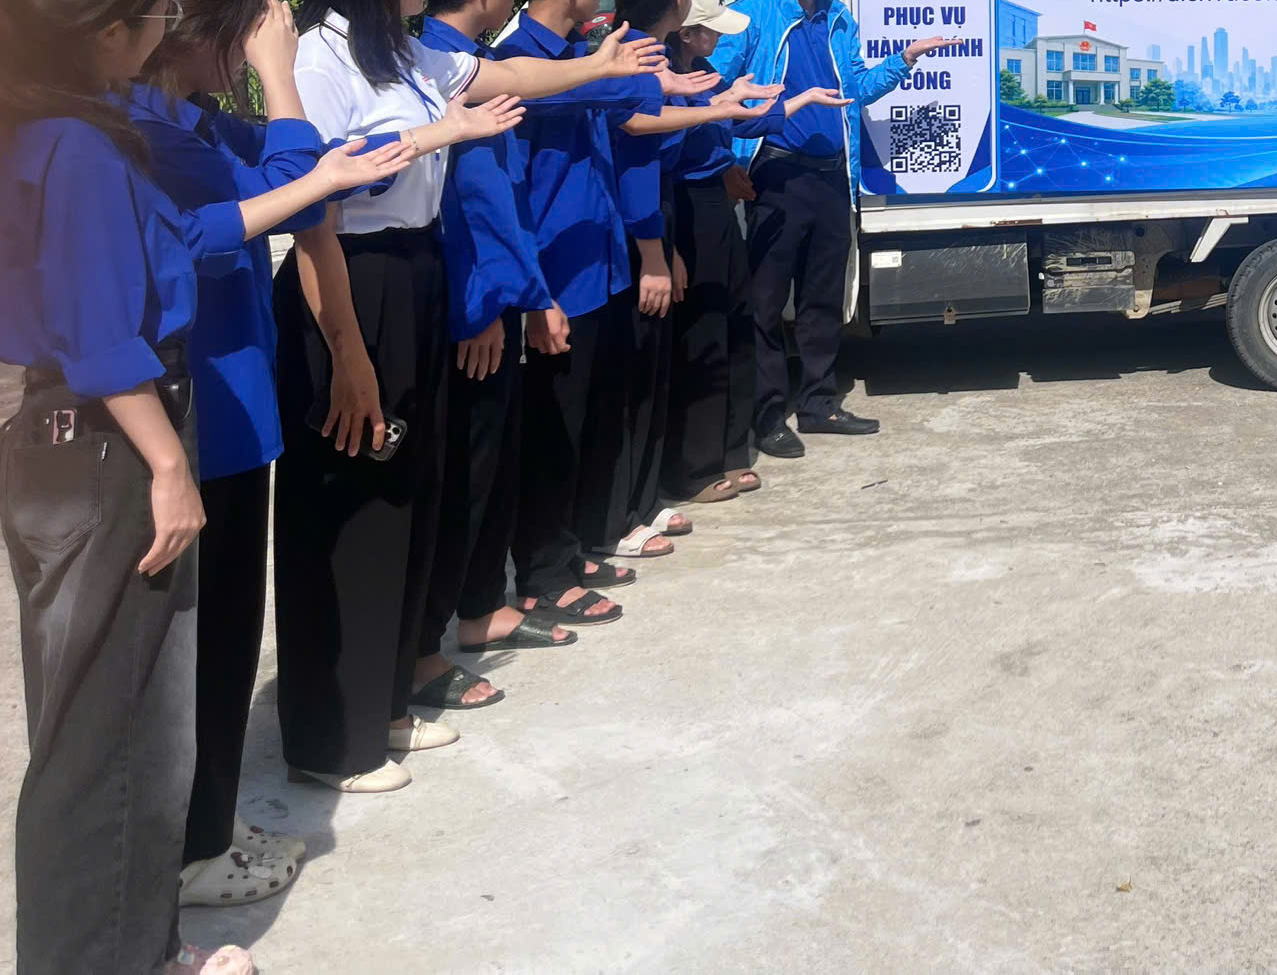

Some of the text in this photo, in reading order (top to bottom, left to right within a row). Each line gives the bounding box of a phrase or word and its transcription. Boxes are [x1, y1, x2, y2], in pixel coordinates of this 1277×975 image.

[884, 7, 965, 29] PHỤC VỤ
[867, 36, 918, 58] HÀN
[900, 68, 952, 90] CÔNG
